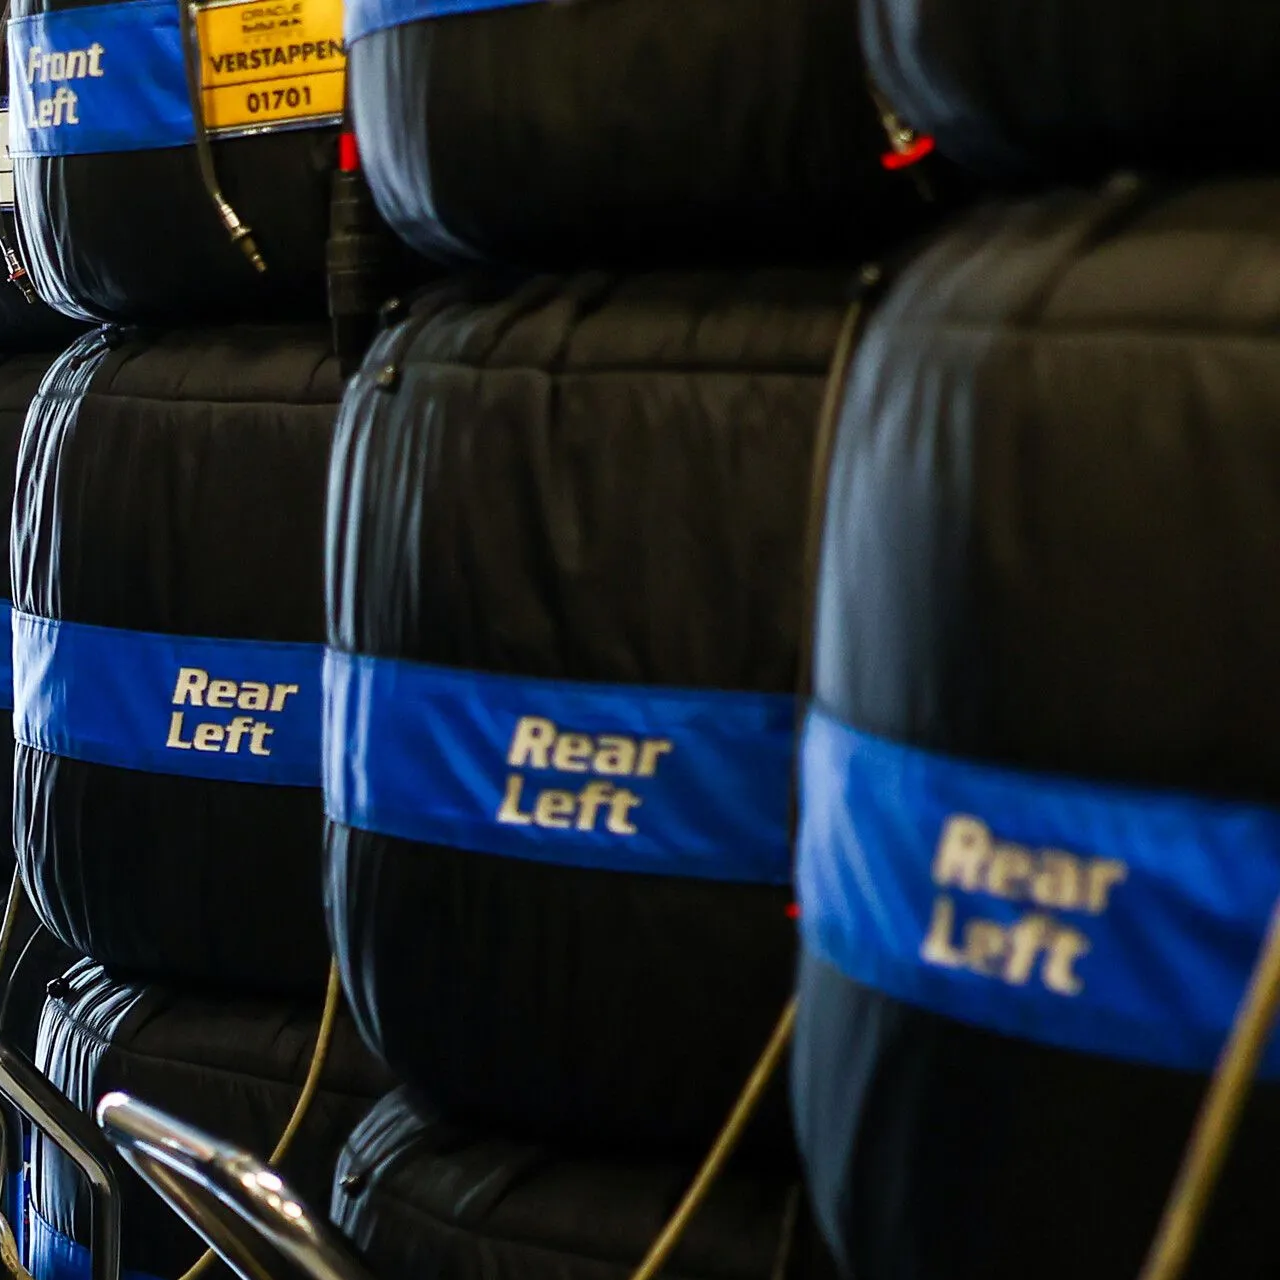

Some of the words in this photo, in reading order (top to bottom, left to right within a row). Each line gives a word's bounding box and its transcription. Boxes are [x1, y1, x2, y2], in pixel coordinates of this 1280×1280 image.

[28, 42, 105, 84] Front
[210, 37, 346, 73] VERSTAPPEN
[27, 87, 79, 129] Left
[247, 86, 312, 113] 01701
[172, 667, 298, 713] Rear
[165, 715, 274, 756] Left
[507, 715, 672, 779] Rear
[496, 773, 643, 836] Left
[930, 812, 1128, 916] Rear
[919, 896, 1091, 996] Left
